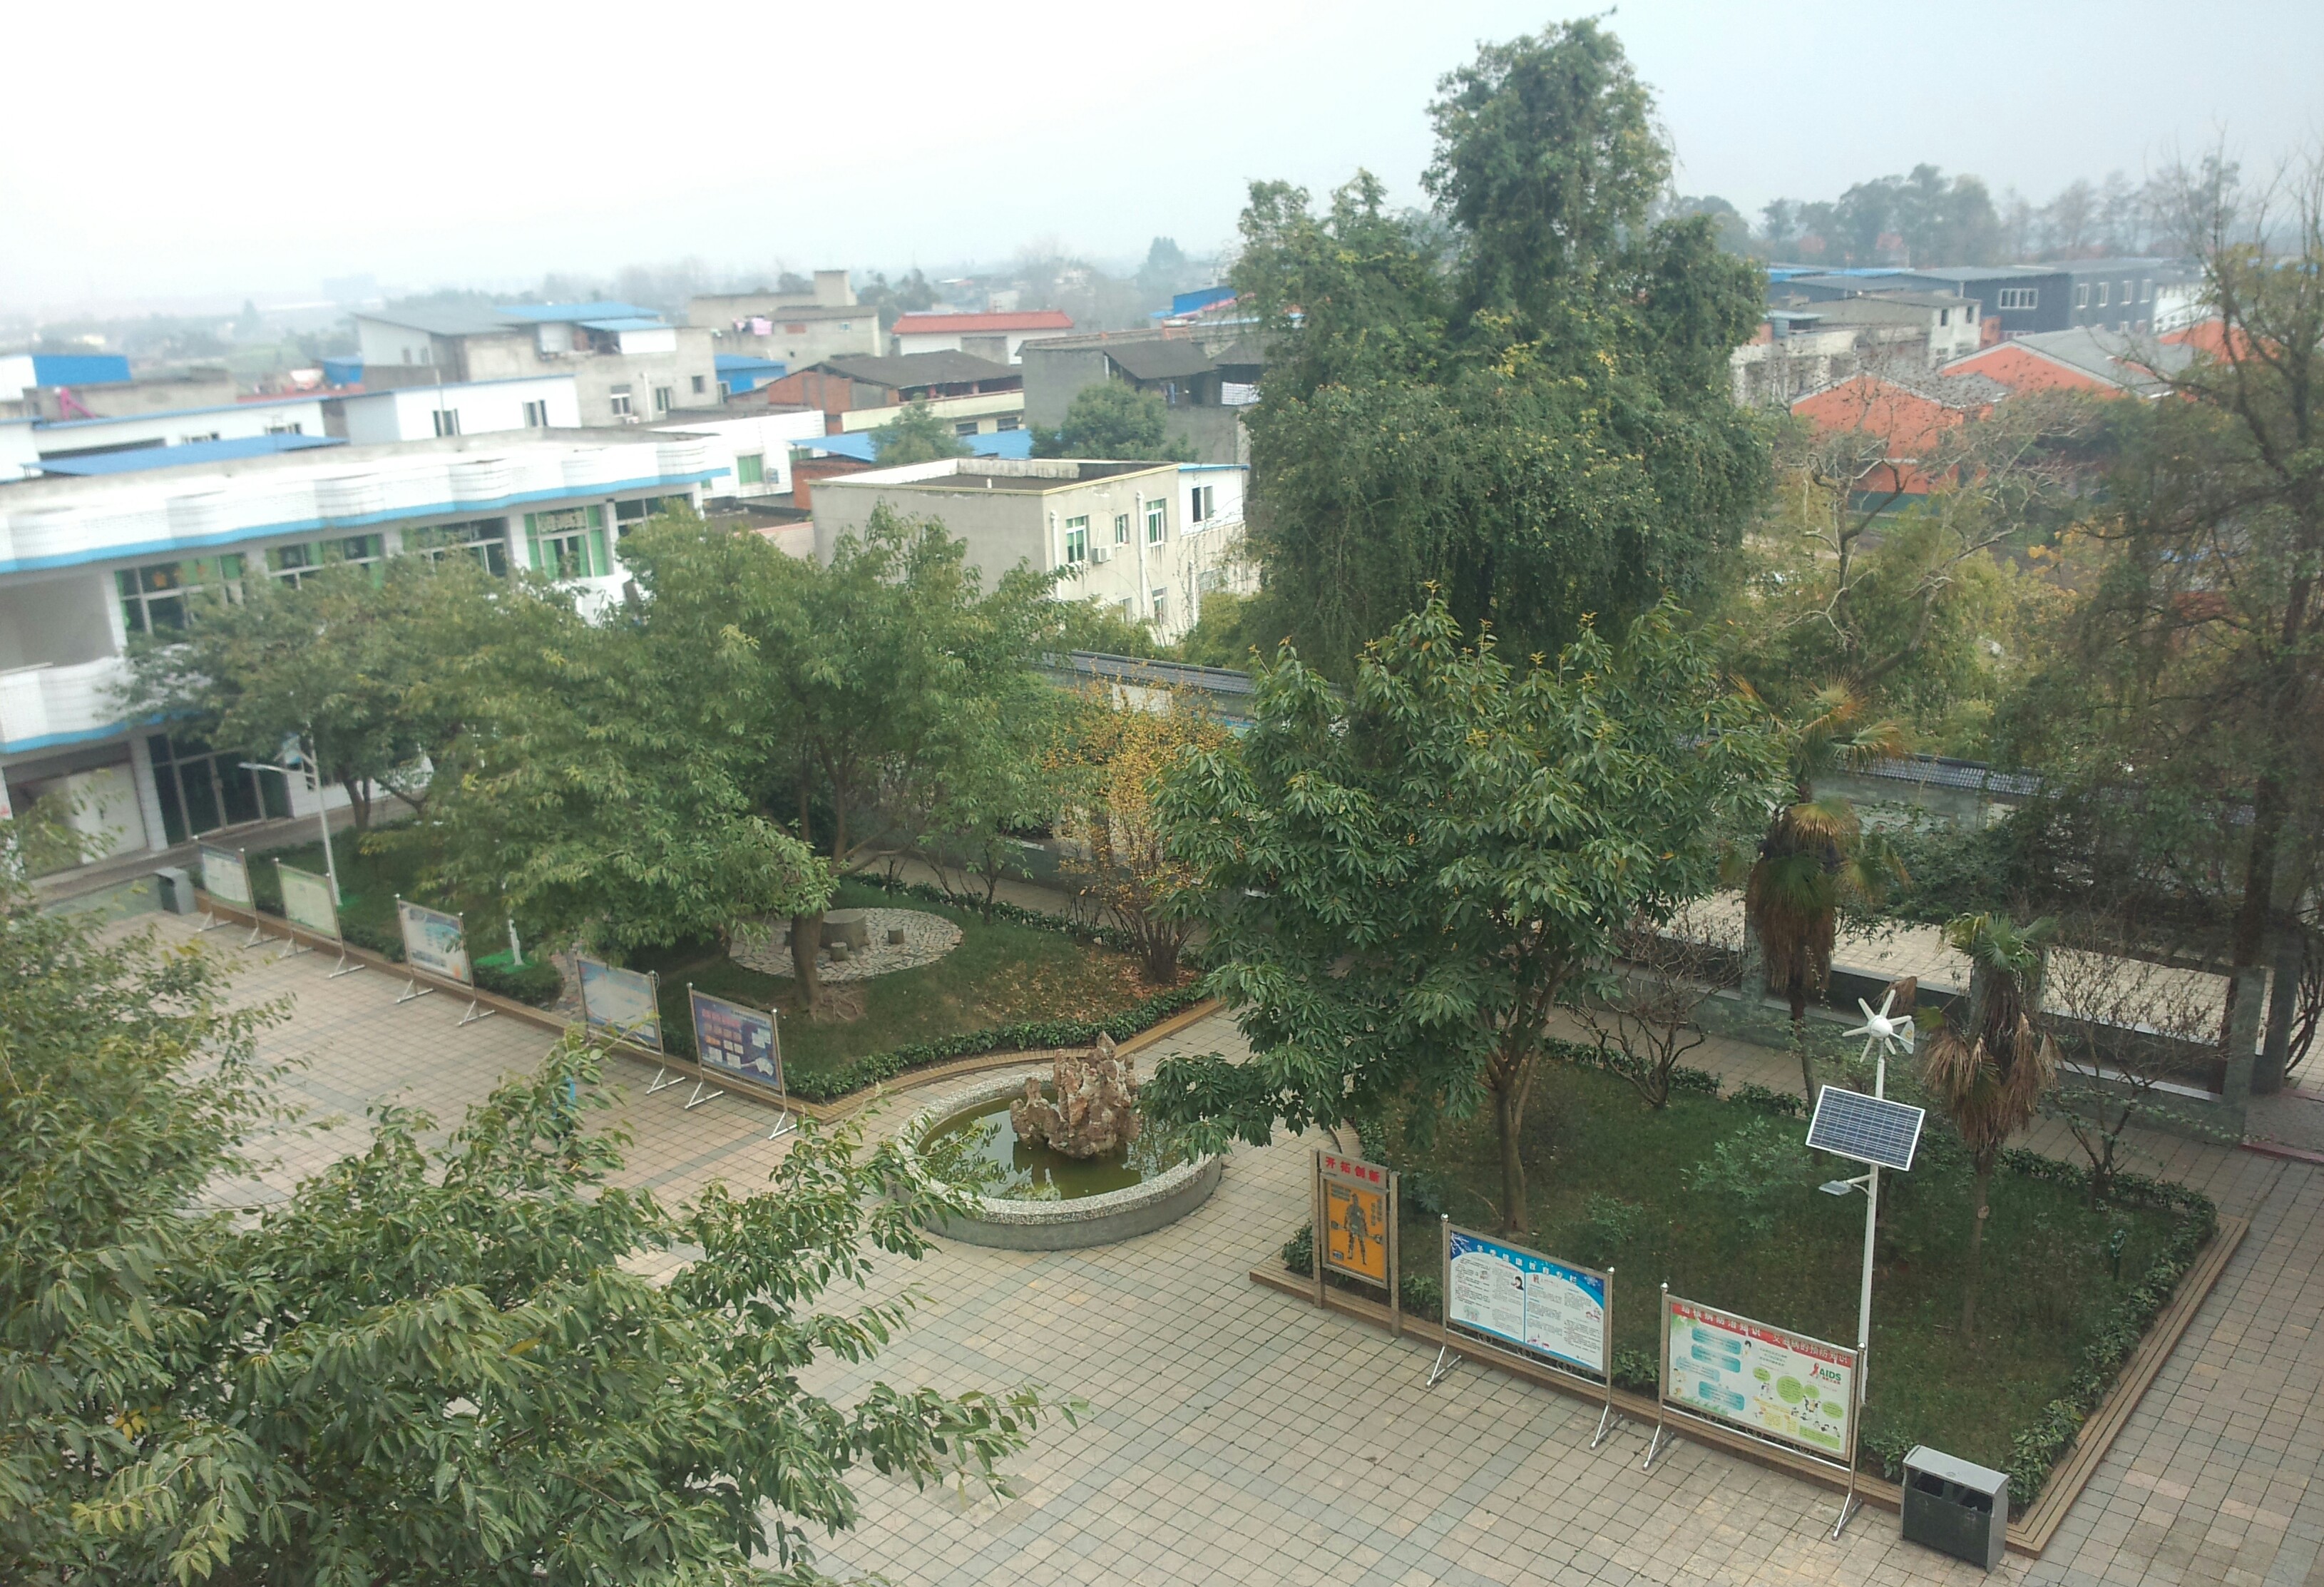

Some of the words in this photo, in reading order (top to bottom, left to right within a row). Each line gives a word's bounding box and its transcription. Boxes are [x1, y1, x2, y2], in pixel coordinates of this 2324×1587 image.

[1326, 1155, 1379, 1183] 开拓创新
[1681, 1306, 1761, 1337] 结核病防治知识
[1819, 1368, 1841, 1382] AIDS
